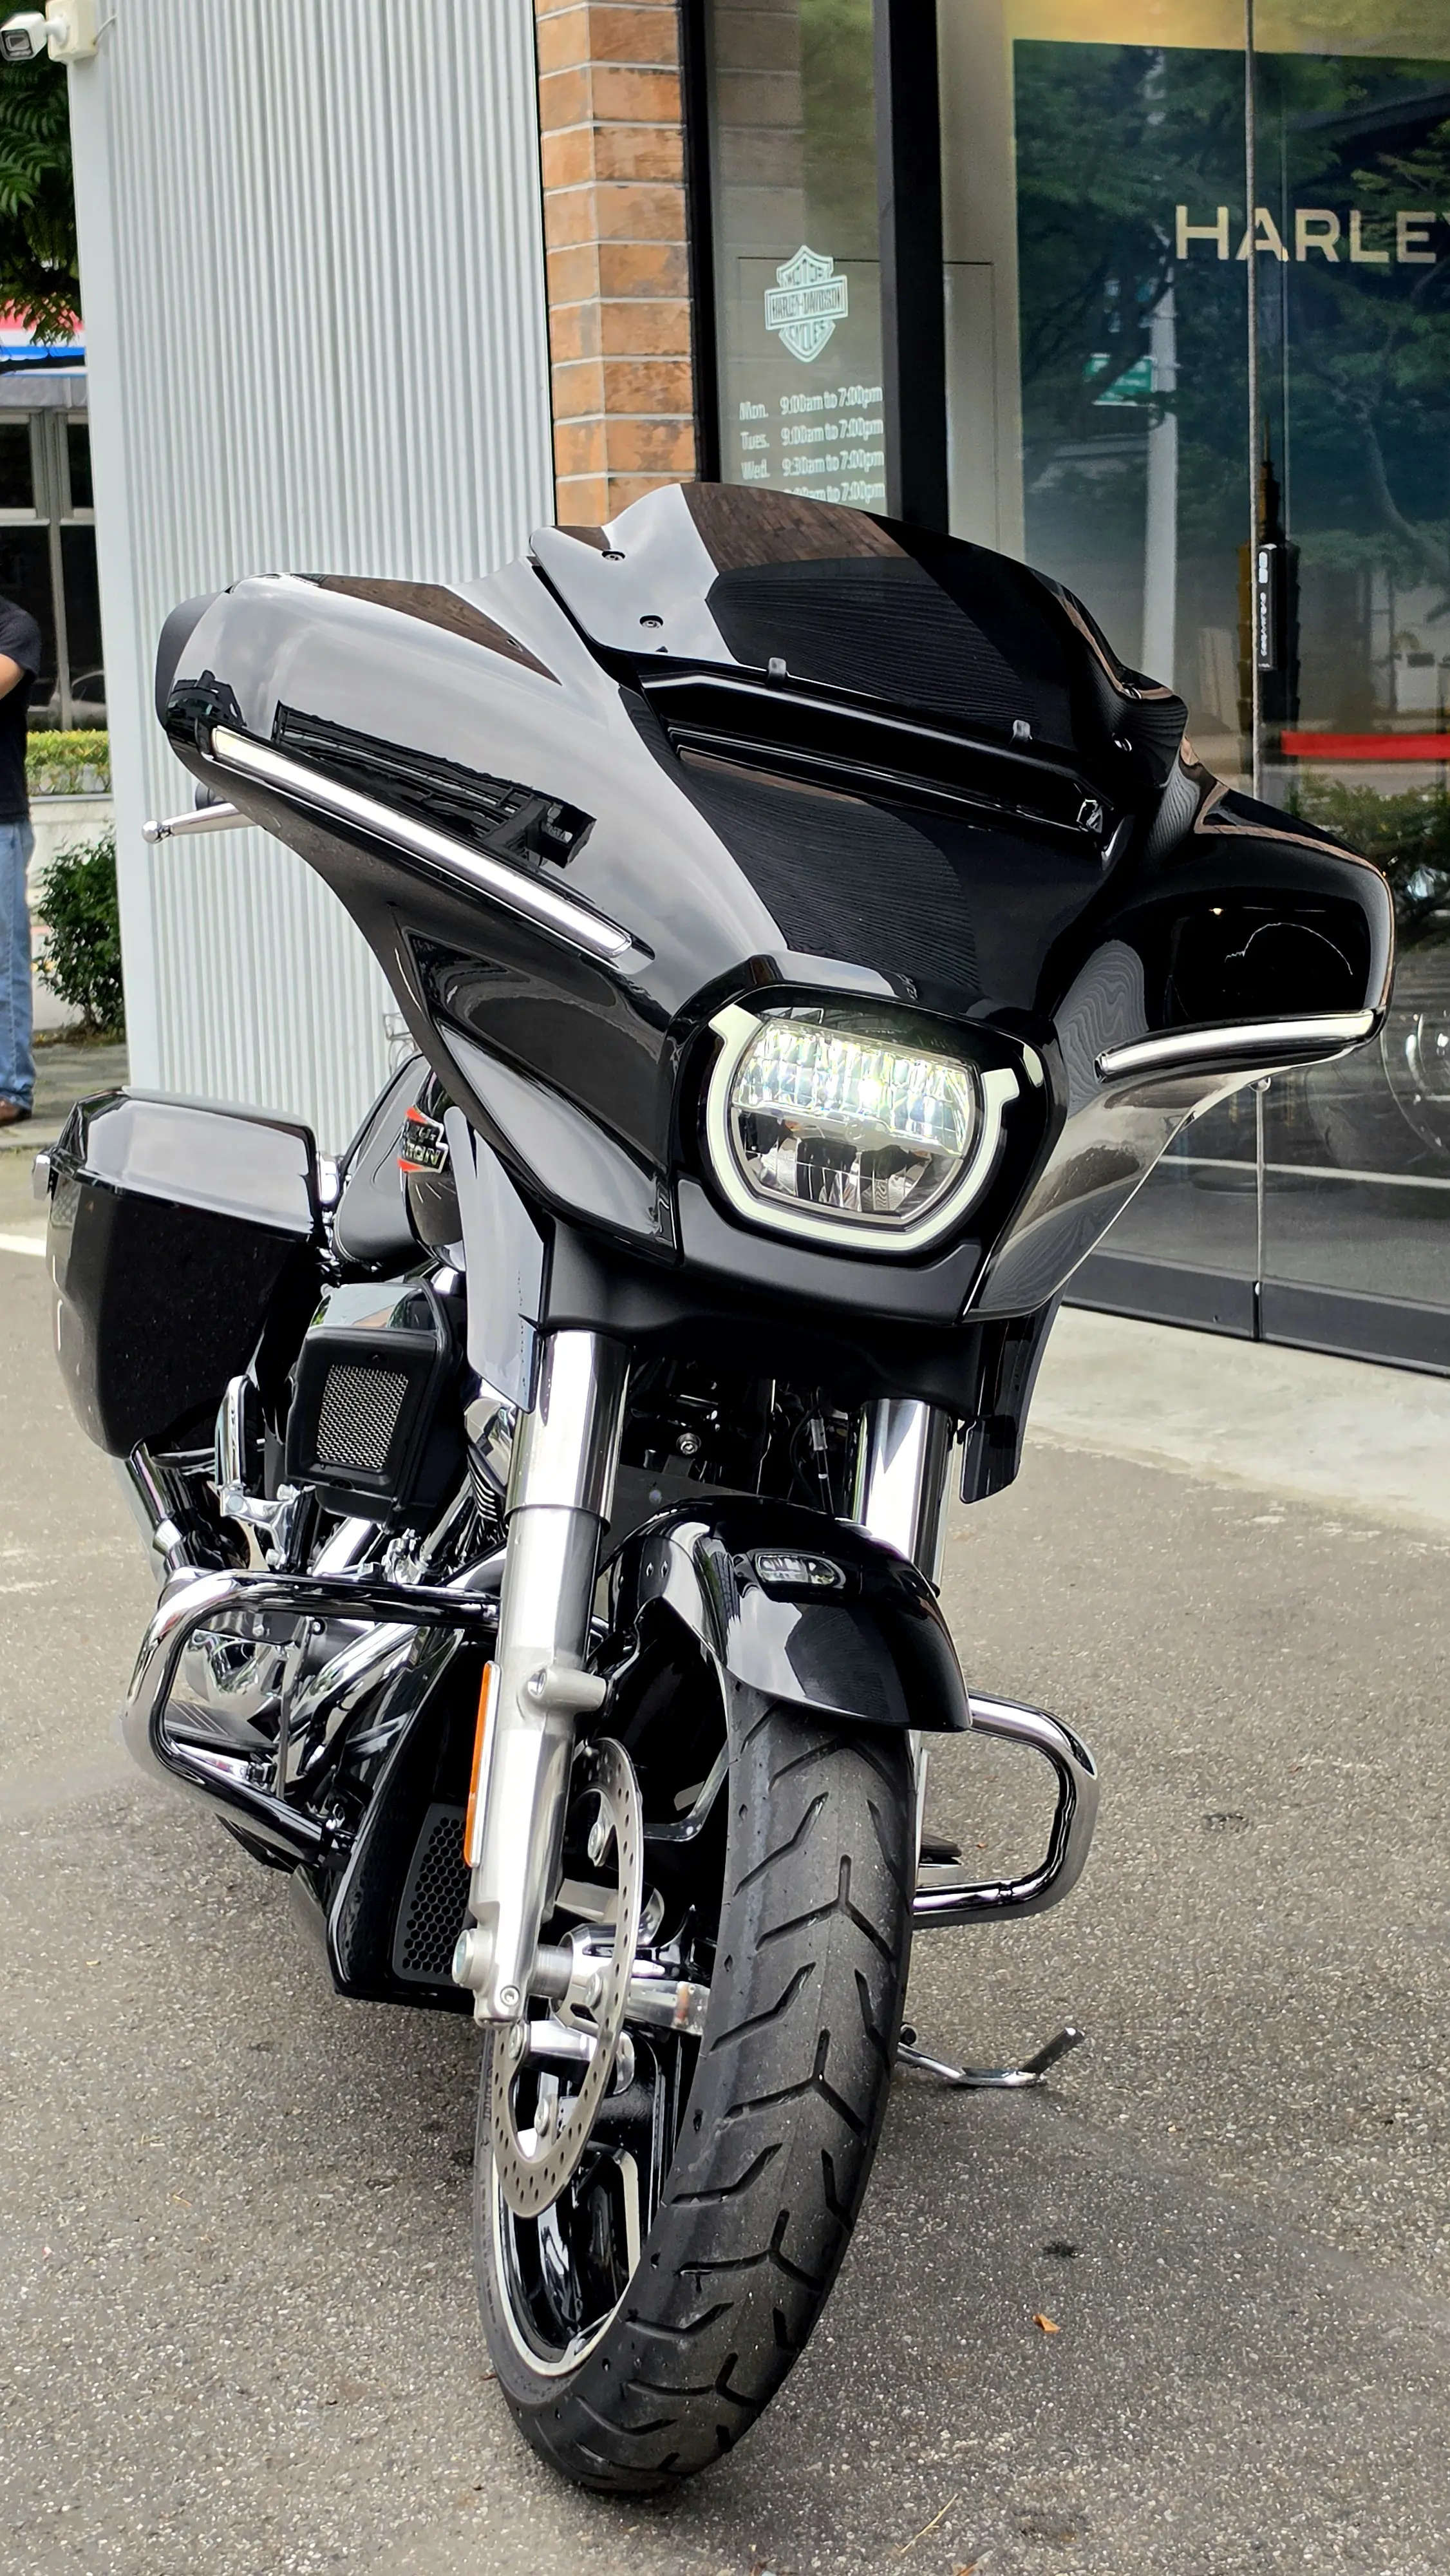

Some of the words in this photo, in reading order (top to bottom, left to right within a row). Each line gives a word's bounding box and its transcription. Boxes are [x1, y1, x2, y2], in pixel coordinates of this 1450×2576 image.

[1176, 204, 1450, 264] HARLE
[772, 286, 841, 319] HARLEY-DAVIDSON
[739, 401, 769, 421] Mon.
[824, 391, 838, 409] to
[740, 431, 770, 451] Tues.
[824, 422, 838, 440] to
[741, 459, 771, 480] Wed.
[825, 453, 840, 471] to
[826, 484, 841, 502] to
